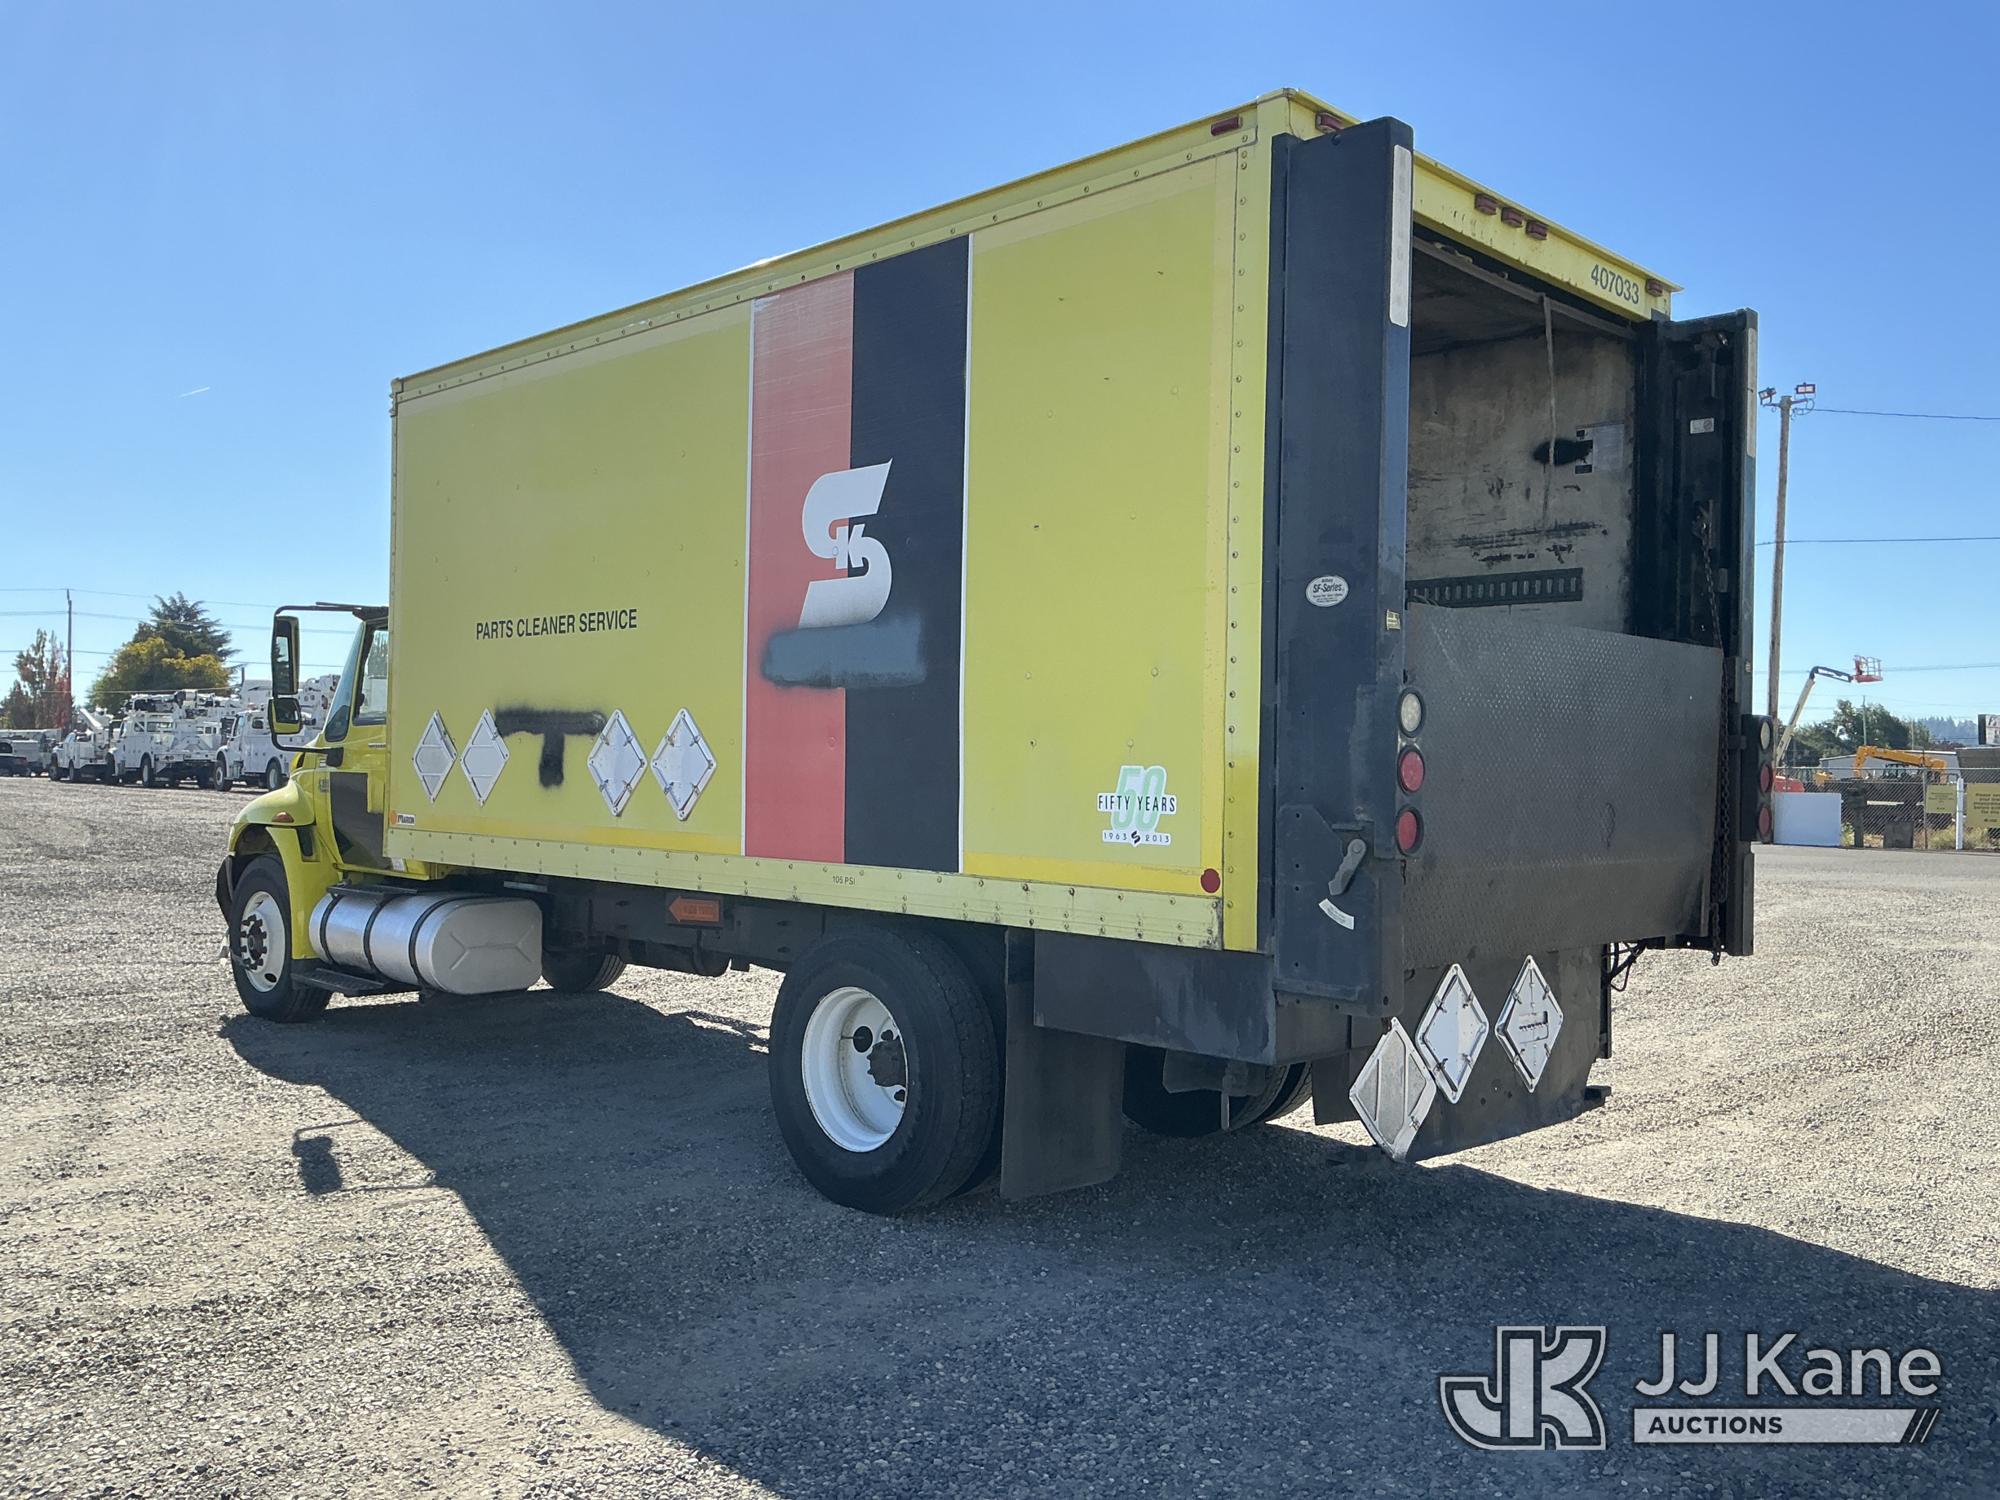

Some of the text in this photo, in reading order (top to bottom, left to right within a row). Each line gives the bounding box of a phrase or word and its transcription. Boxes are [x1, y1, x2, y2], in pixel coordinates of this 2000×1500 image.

[1590, 263, 1639, 305] 407033
[476, 608, 638, 640] PARTS CLEANER SERVICE
[1098, 795, 1176, 812] FIFTY YEARS
[1103, 832, 1128, 841] 1963
[1145, 834, 1170, 843] 2013
[832, 875, 856, 886] 105 PSI
